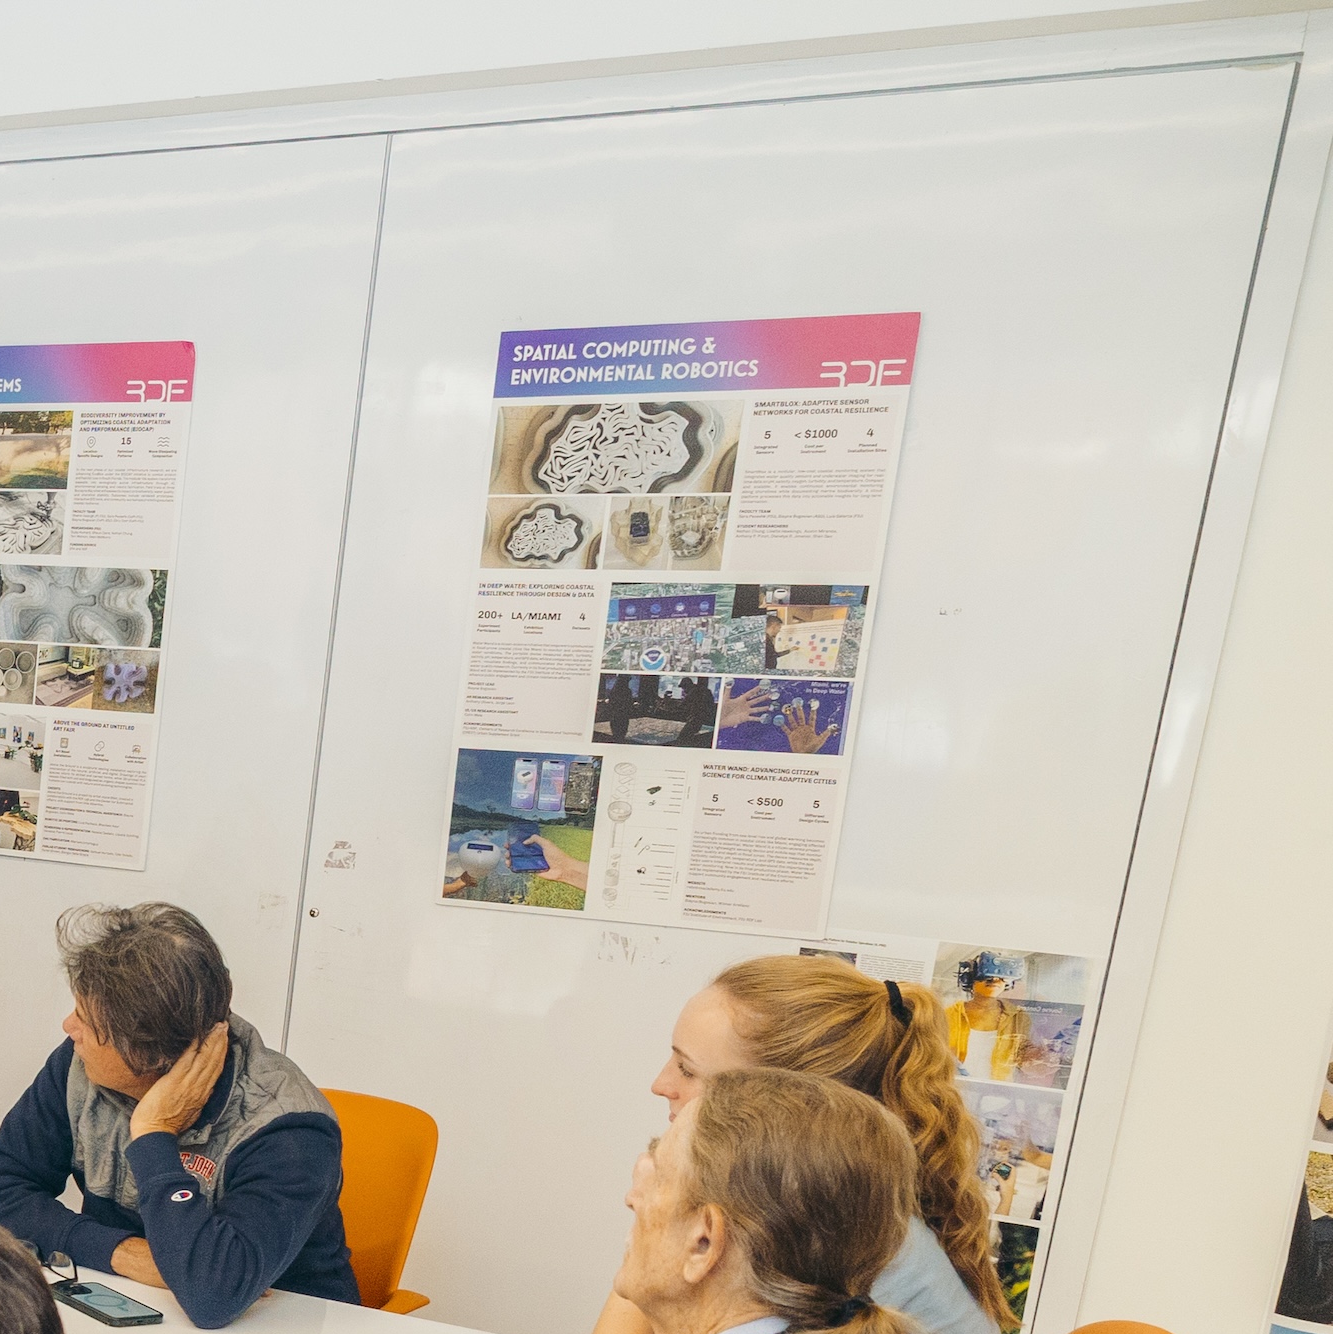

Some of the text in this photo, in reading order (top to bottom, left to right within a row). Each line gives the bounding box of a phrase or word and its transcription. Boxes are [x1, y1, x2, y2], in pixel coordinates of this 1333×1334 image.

[513, 337, 716, 362] SPATIAL COMPUTING &
[510, 359, 759, 385] ENVIRONMENTAL ROBOTICS
[764, 431, 772, 439] 5
[804, 429, 838, 439] $1000
[866, 428, 874, 437] 4
[121, 437, 132, 445] 15
[478, 611, 503, 619] 200+
[511, 612, 561, 621] LA/MIAMI
[579, 613, 586, 621] 4
[792, 768, 820, 776] CITIZEN
[745, 774, 812, 784] CLIMATE-ADAPTIVE
[814, 777, 837, 785] CITIES
[712, 794, 719, 802] 5
[757, 797, 783, 807] $500
[813, 800, 820, 809] 5
[188, 1154, 216, 1182] JOHN
